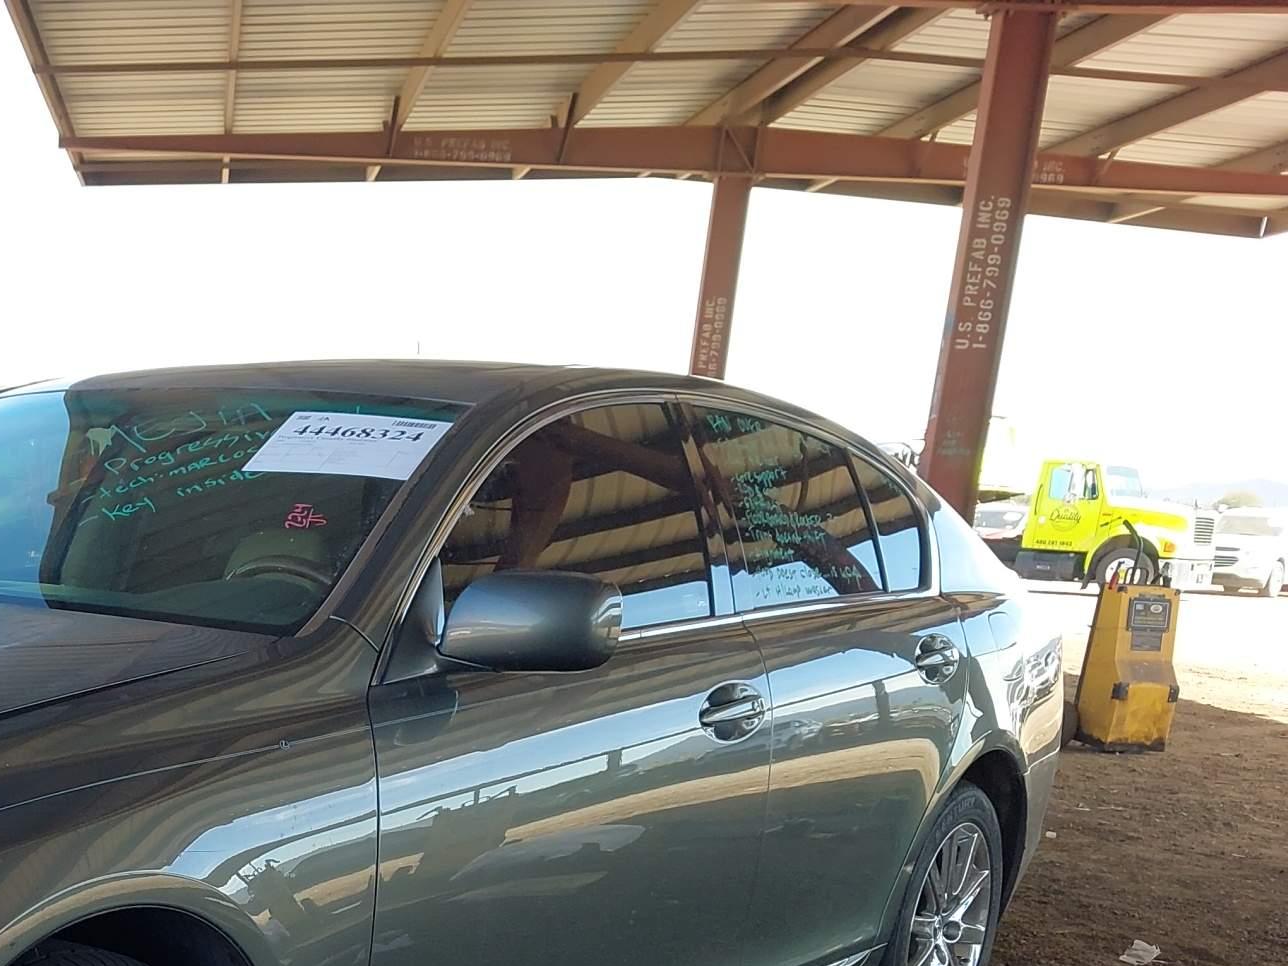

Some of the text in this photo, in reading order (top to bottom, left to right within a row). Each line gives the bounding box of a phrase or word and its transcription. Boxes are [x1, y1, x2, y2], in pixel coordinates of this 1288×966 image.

[963, 237, 987, 306] PREFAB
[975, 195, 995, 229] INC.
[972, 197, 1011, 348] 1-866-799-0969
[104, 430, 275, 475] Progressiv
[294, 424, 424, 443] 44468324
[1049, 508, 1082, 524] Quality
